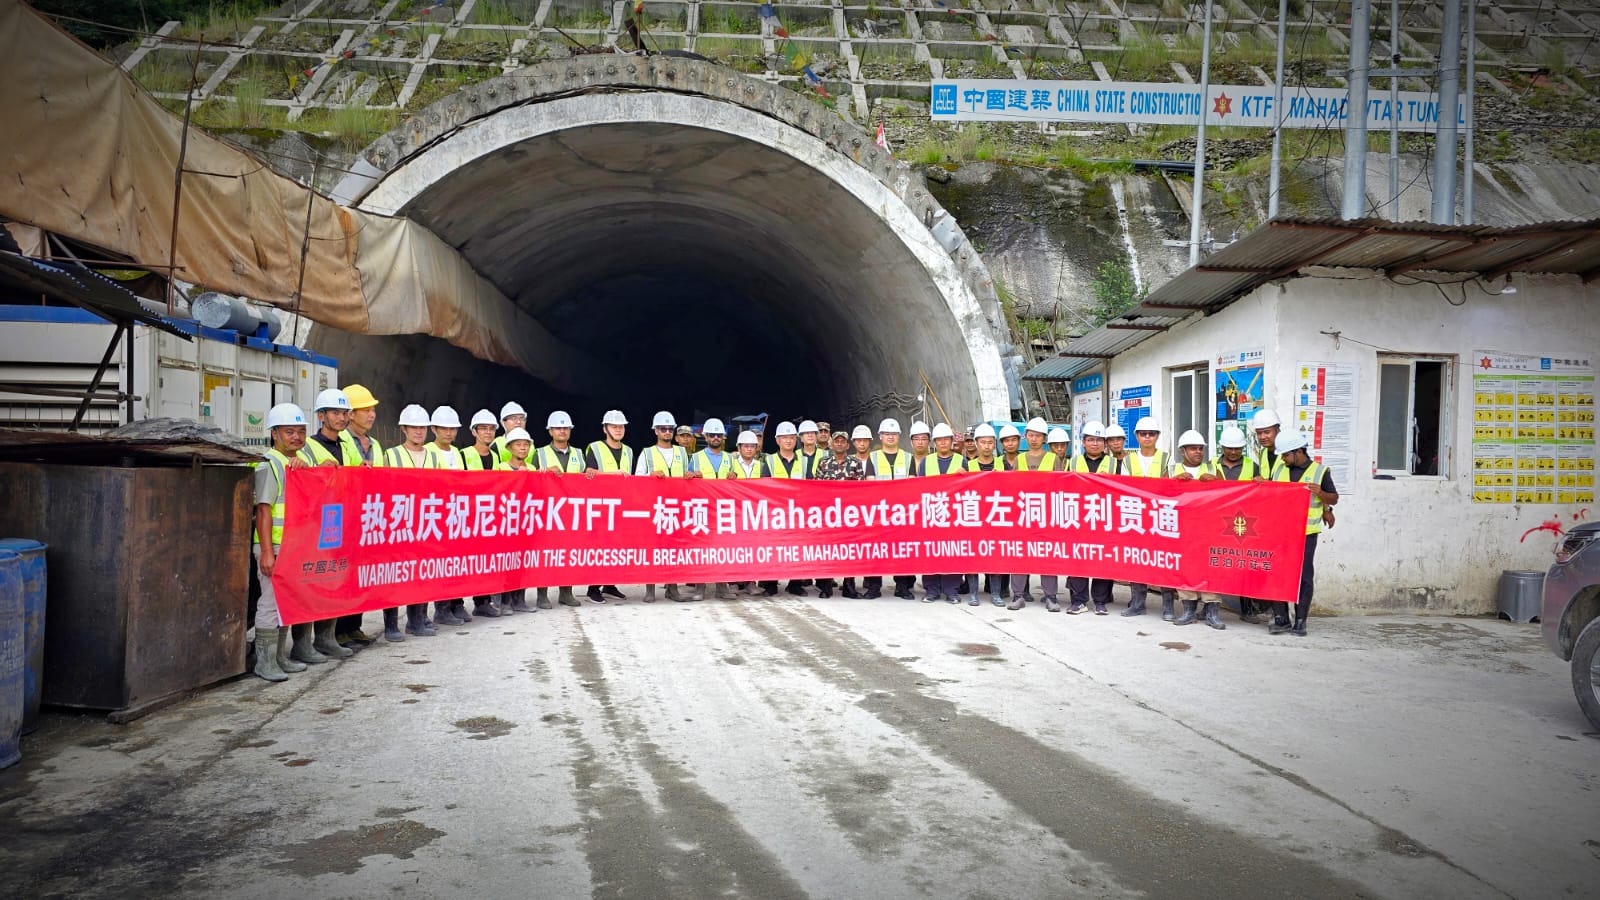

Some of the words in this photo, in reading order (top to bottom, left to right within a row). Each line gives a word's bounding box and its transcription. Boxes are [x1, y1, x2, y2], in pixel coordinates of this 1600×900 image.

[1057, 89, 1090, 112] CHINA
[1095, 90, 1125, 113] STATE
[1130, 91, 1202, 116] CONSTRUCTIO
[1241, 95, 1275, 118] KTF
[1289, 97, 1403, 121] MAHADVTAR
[1407, 101, 1465, 124] TUNL
[358, 560, 417, 588] WARMEST
[419, 551, 522, 580] CONGRATULATIONS
[524, 549, 540, 568] ON
[543, 549, 566, 567] THE
[569, 548, 650, 566] SUCCESSFUL
[653, 547, 754, 565] BREAKTHROUGH
[756, 546, 773, 564] OF
[775, 545, 800, 562] THE
[802, 543, 889, 561] MAHADEVTAR
[892, 542, 921, 559] LEFT
[924, 540, 976, 557] TUNNEL
[978, 540, 996, 556] OF
[999, 540, 1024, 557] THE
[1027, 541, 1069, 559] NEPAL
[1072, 543, 1119, 563] KTFT-1
[1123, 546, 1183, 571] PROJECT
[1209, 547, 1244, 557] NEPALI
[1246, 549, 1274, 559] ARMY
